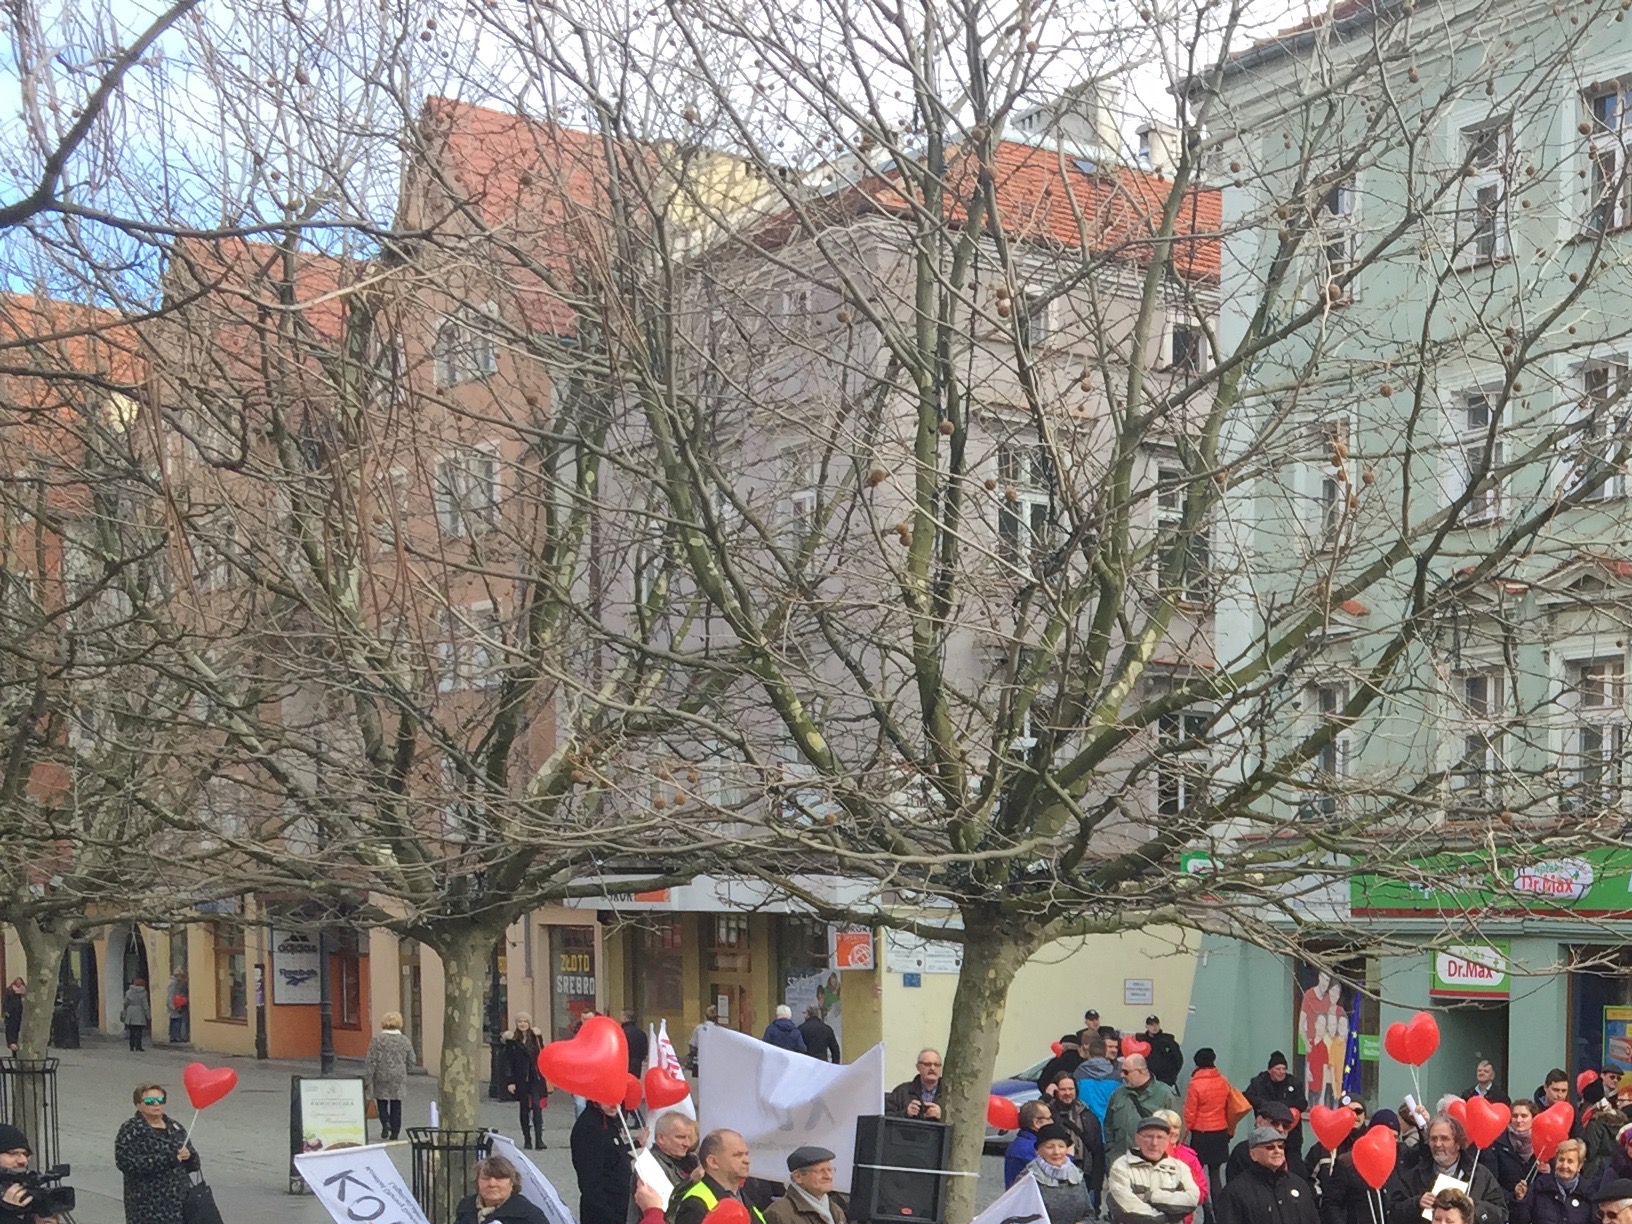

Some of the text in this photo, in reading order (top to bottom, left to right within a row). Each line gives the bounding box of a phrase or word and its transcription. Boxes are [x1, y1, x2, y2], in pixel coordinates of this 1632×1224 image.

[278, 943, 318, 953] adidas
[560, 953, 590, 972] ZŁOTO
[1448, 959, 1493, 979] Dr.Max
[556, 975, 595, 995] SREBRO
